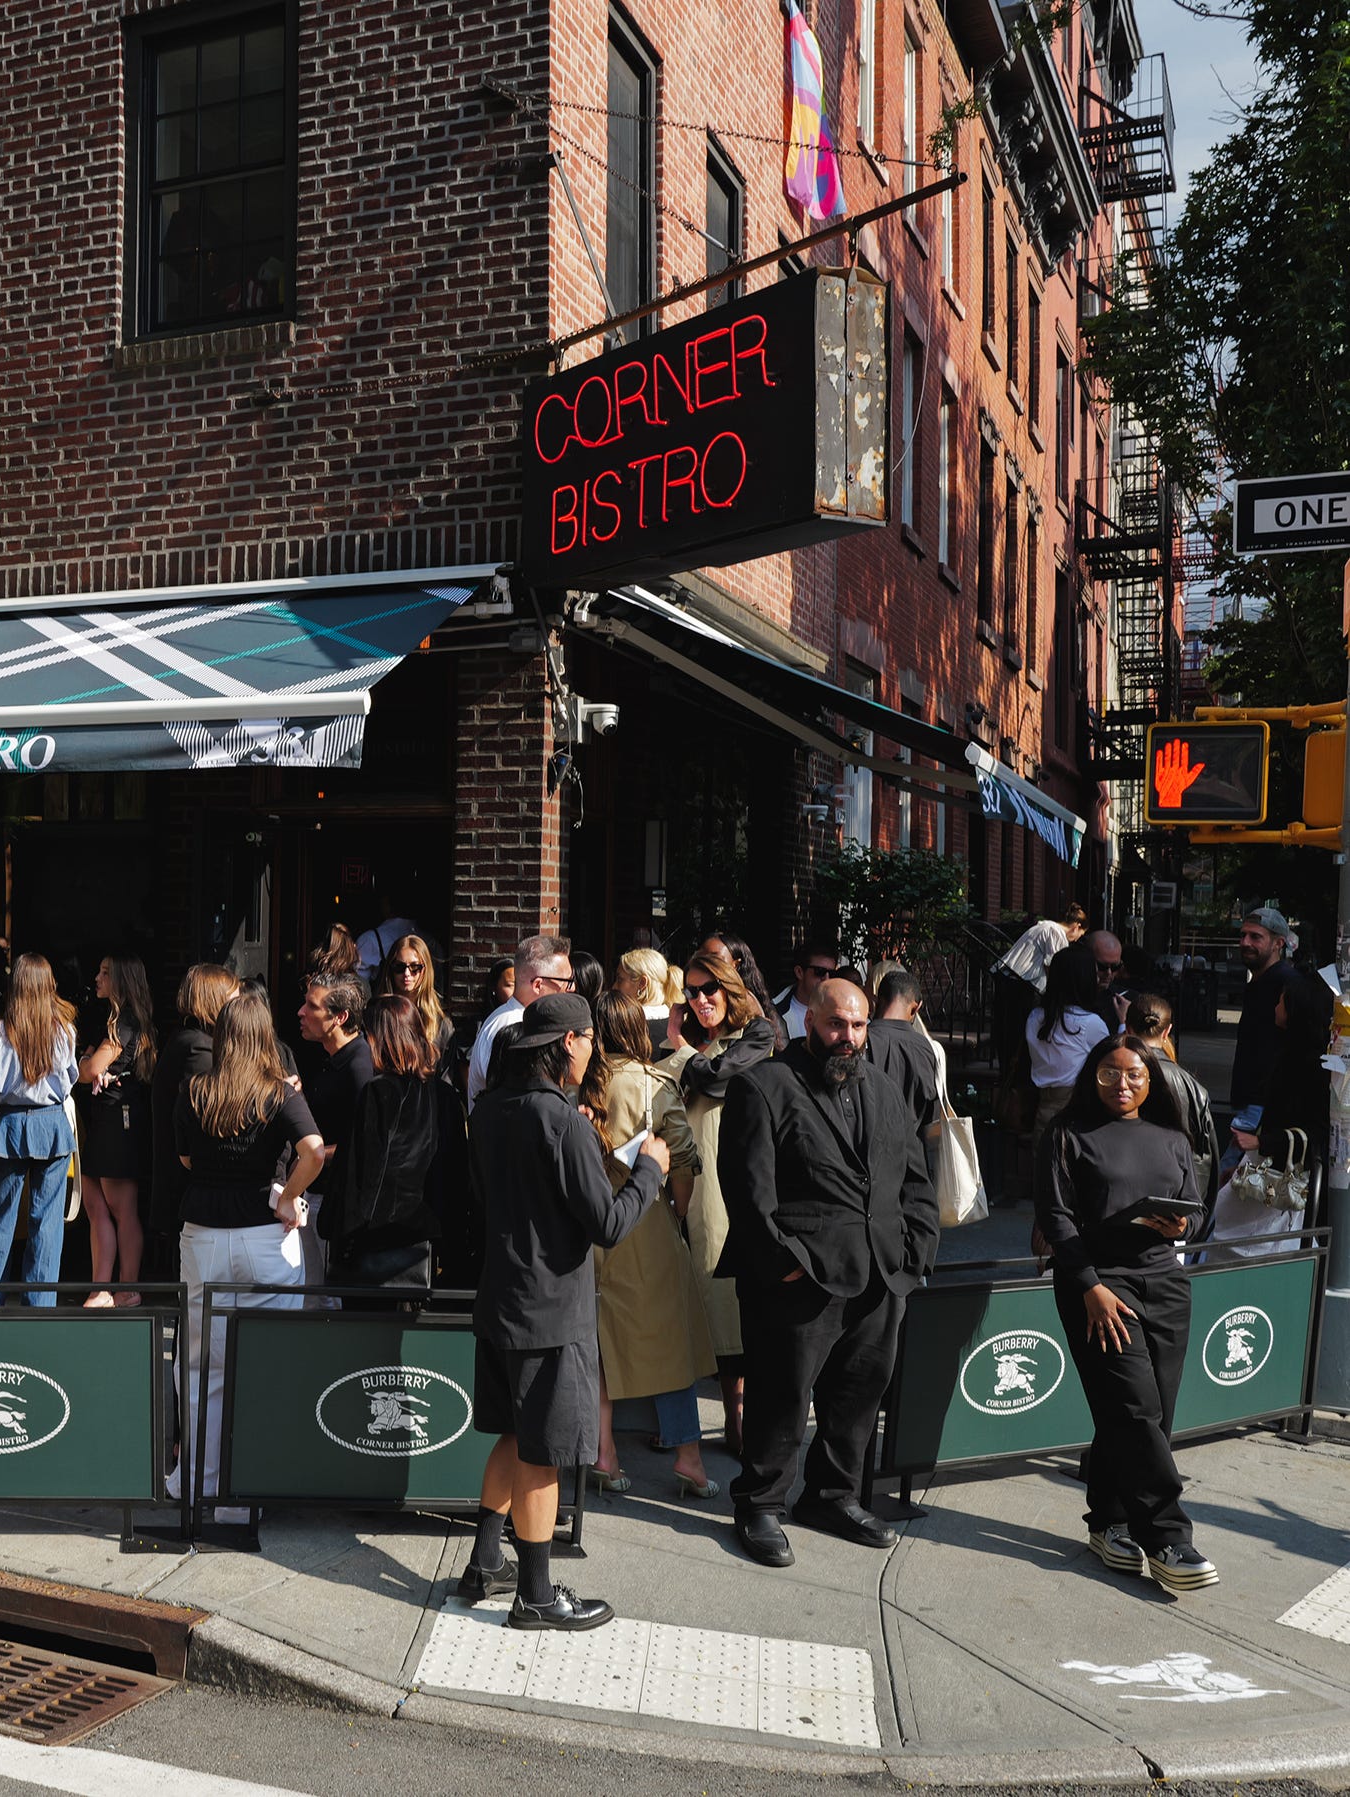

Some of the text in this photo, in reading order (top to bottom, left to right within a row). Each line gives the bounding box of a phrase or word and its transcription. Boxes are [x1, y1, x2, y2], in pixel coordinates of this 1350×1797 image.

[535, 315, 776, 463] CORNER
[552, 432, 746, 554] BISTRO
[1274, 497, 1348, 528] ONE
[1225, 1312, 1258, 1330] BURBERRY
[992, 1337, 1040, 1355] BURBERRY
[361, 1374, 432, 1390] BURBERRY
[986, 1394, 1035, 1408] CORNER BISTRO
[356, 1437, 429, 1450] CORNER BISTRO
